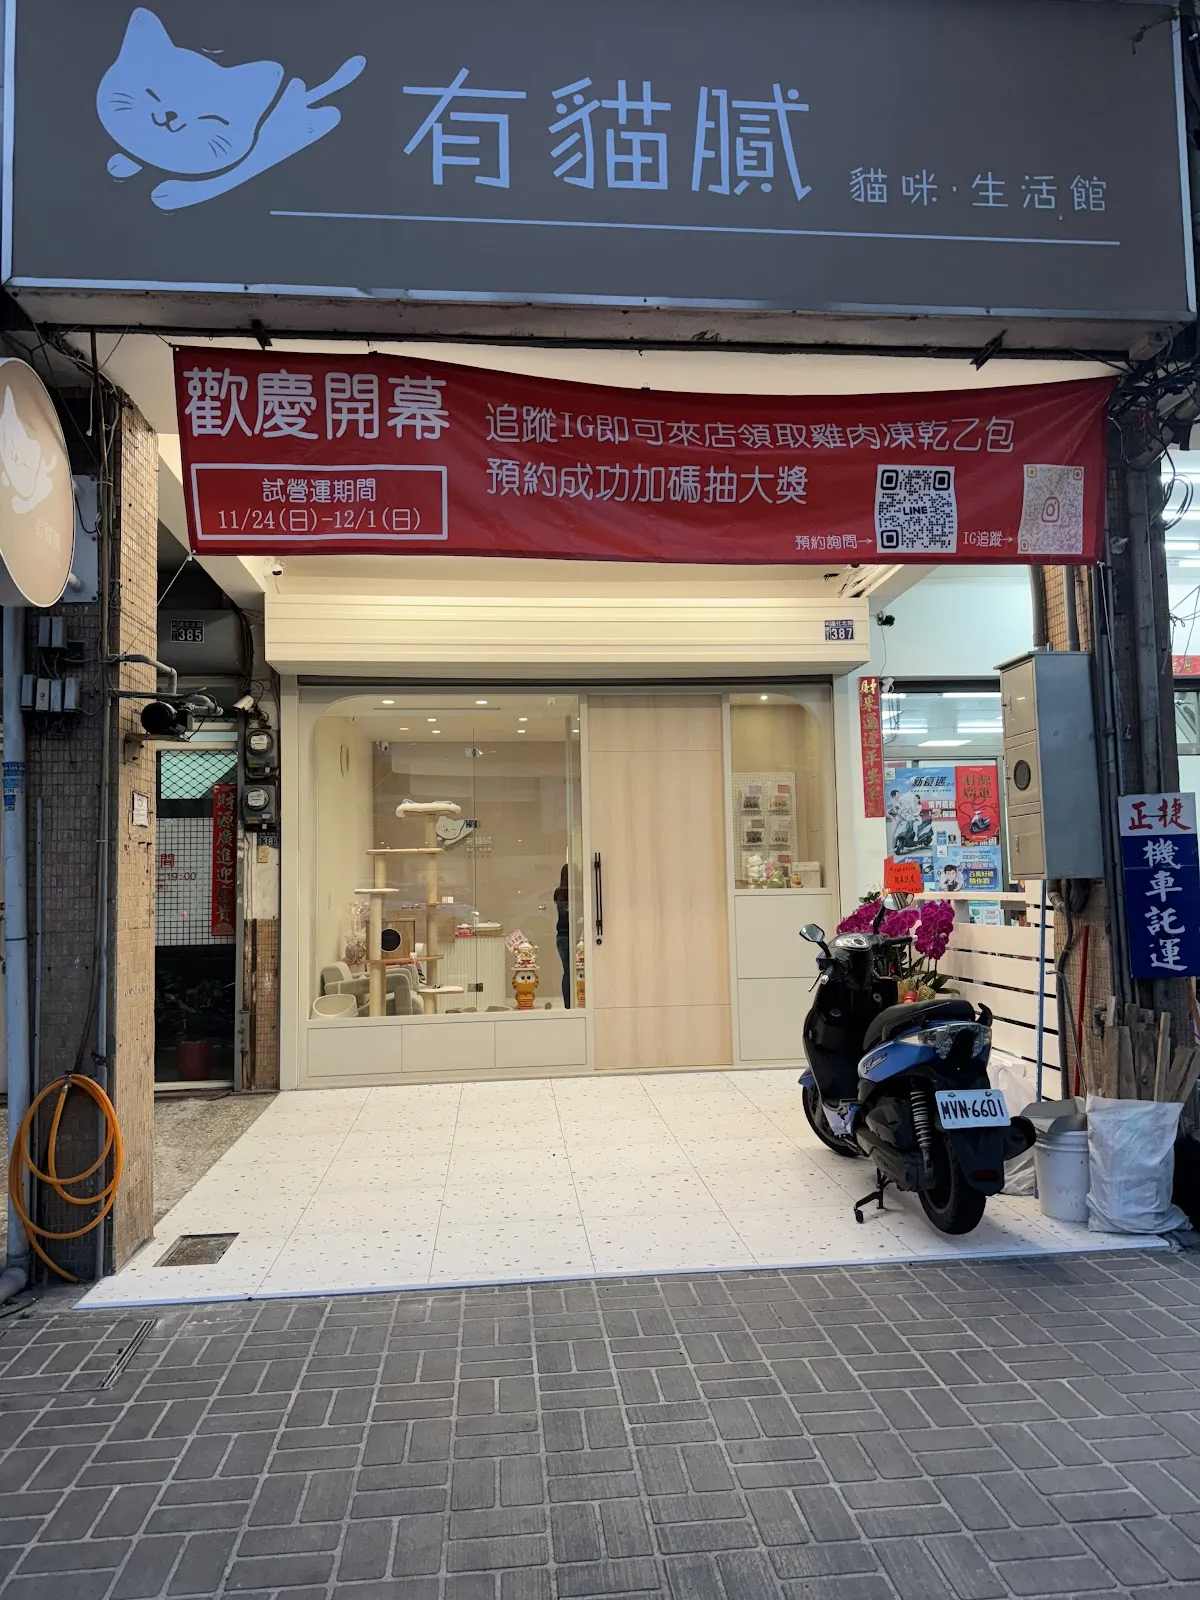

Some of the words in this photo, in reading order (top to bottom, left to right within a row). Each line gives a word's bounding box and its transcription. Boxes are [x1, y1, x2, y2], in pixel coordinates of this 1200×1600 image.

[402, 67, 812, 201] 有貓膩
[183, 366, 450, 440] 歡慶開幕
[485, 402, 1015, 454] 追蹤IG即可來店領取雞肉凍乾乙包
[262, 477, 377, 504] 試營運期間
[485, 457, 808, 504] 預約成功加碼抽大獎
[218, 507, 422, 532] 11/24(日)-12/1(日)
[903, 505, 928, 516] LINE
[795, 534, 857, 551] 預約詢問
[963, 531, 1003, 548] IG追蹤
[178, 629, 202, 641] 385
[831, 628, 853, 640] 387
[1128, 798, 1191, 831] 正捷
[1142, 837, 1188, 972] 機車託運
